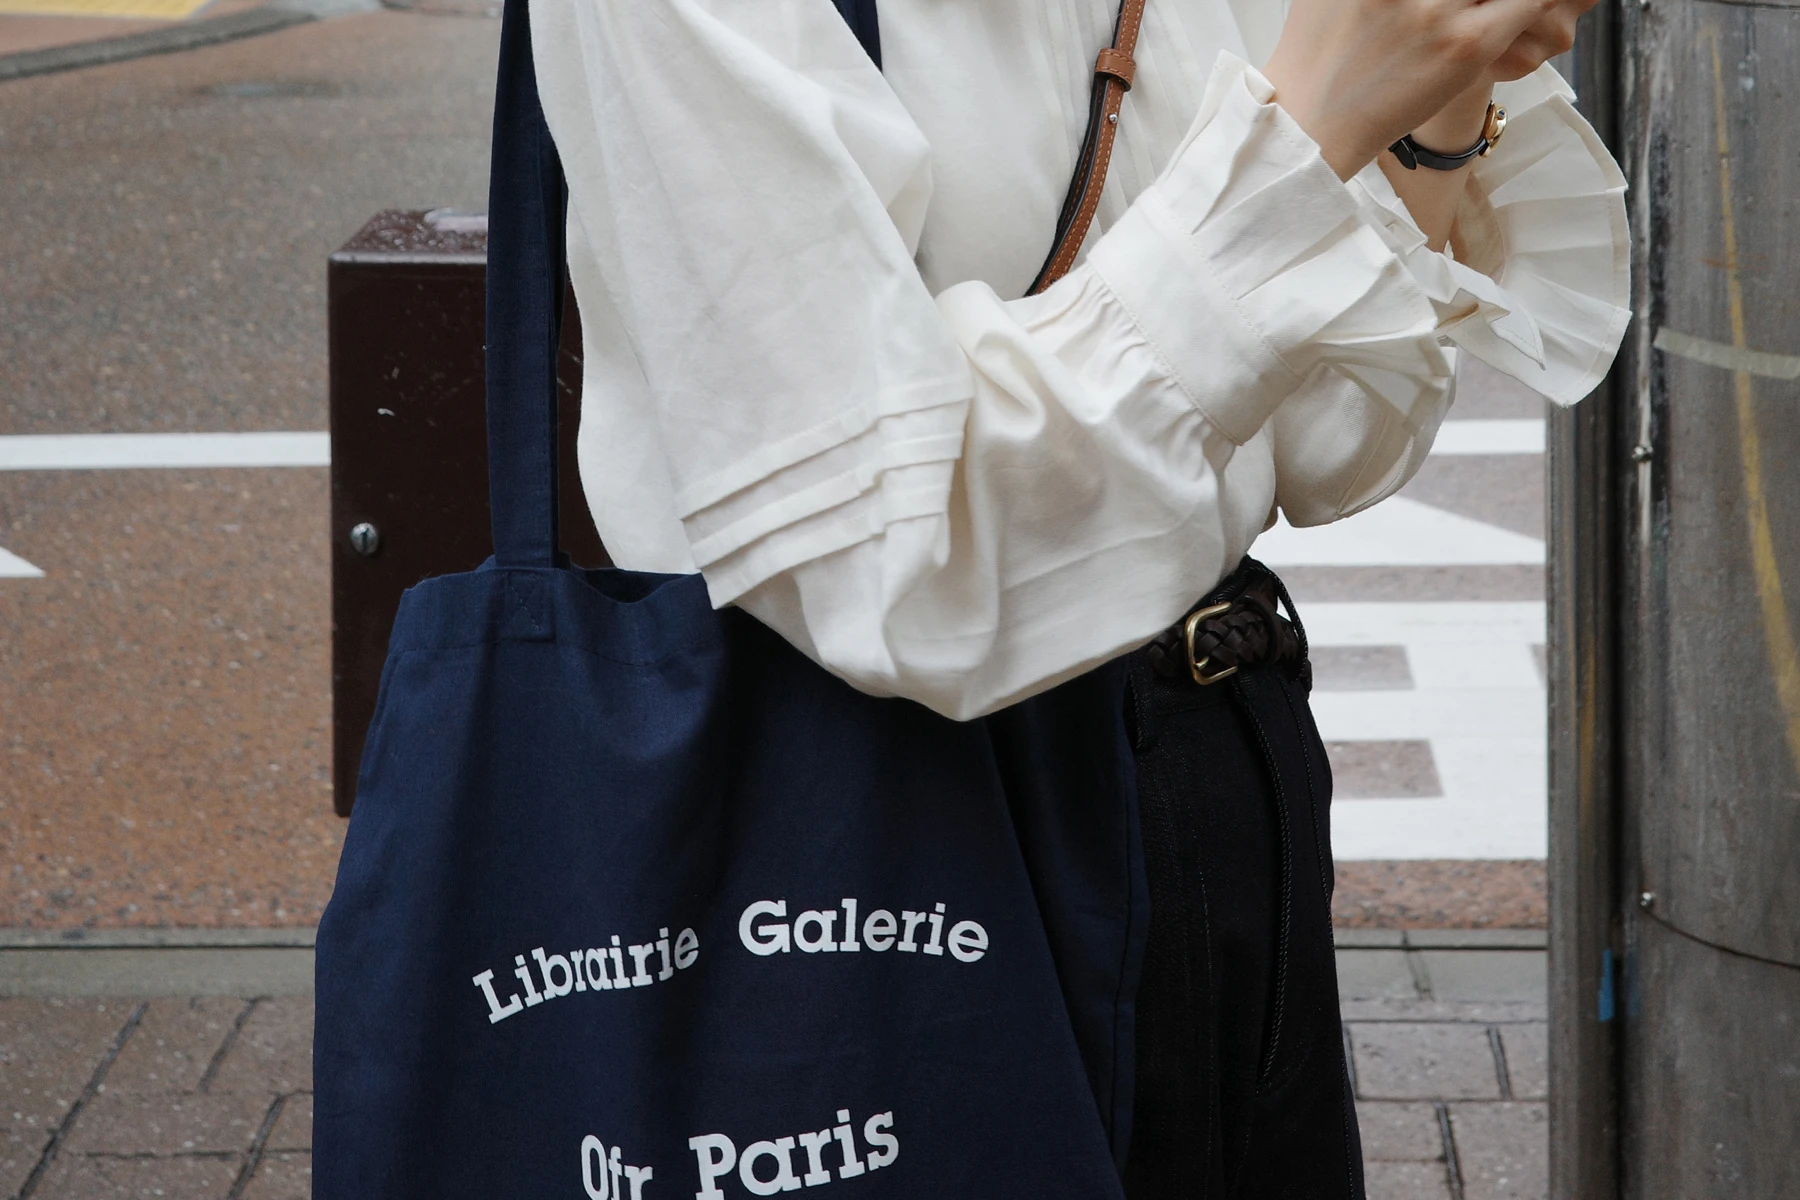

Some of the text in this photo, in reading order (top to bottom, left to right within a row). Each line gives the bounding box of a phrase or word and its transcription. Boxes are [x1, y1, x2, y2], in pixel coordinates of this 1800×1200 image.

[473, 898, 989, 1024] Librairie Galerie
[580, 1108, 900, 1200] Ofr Paris
